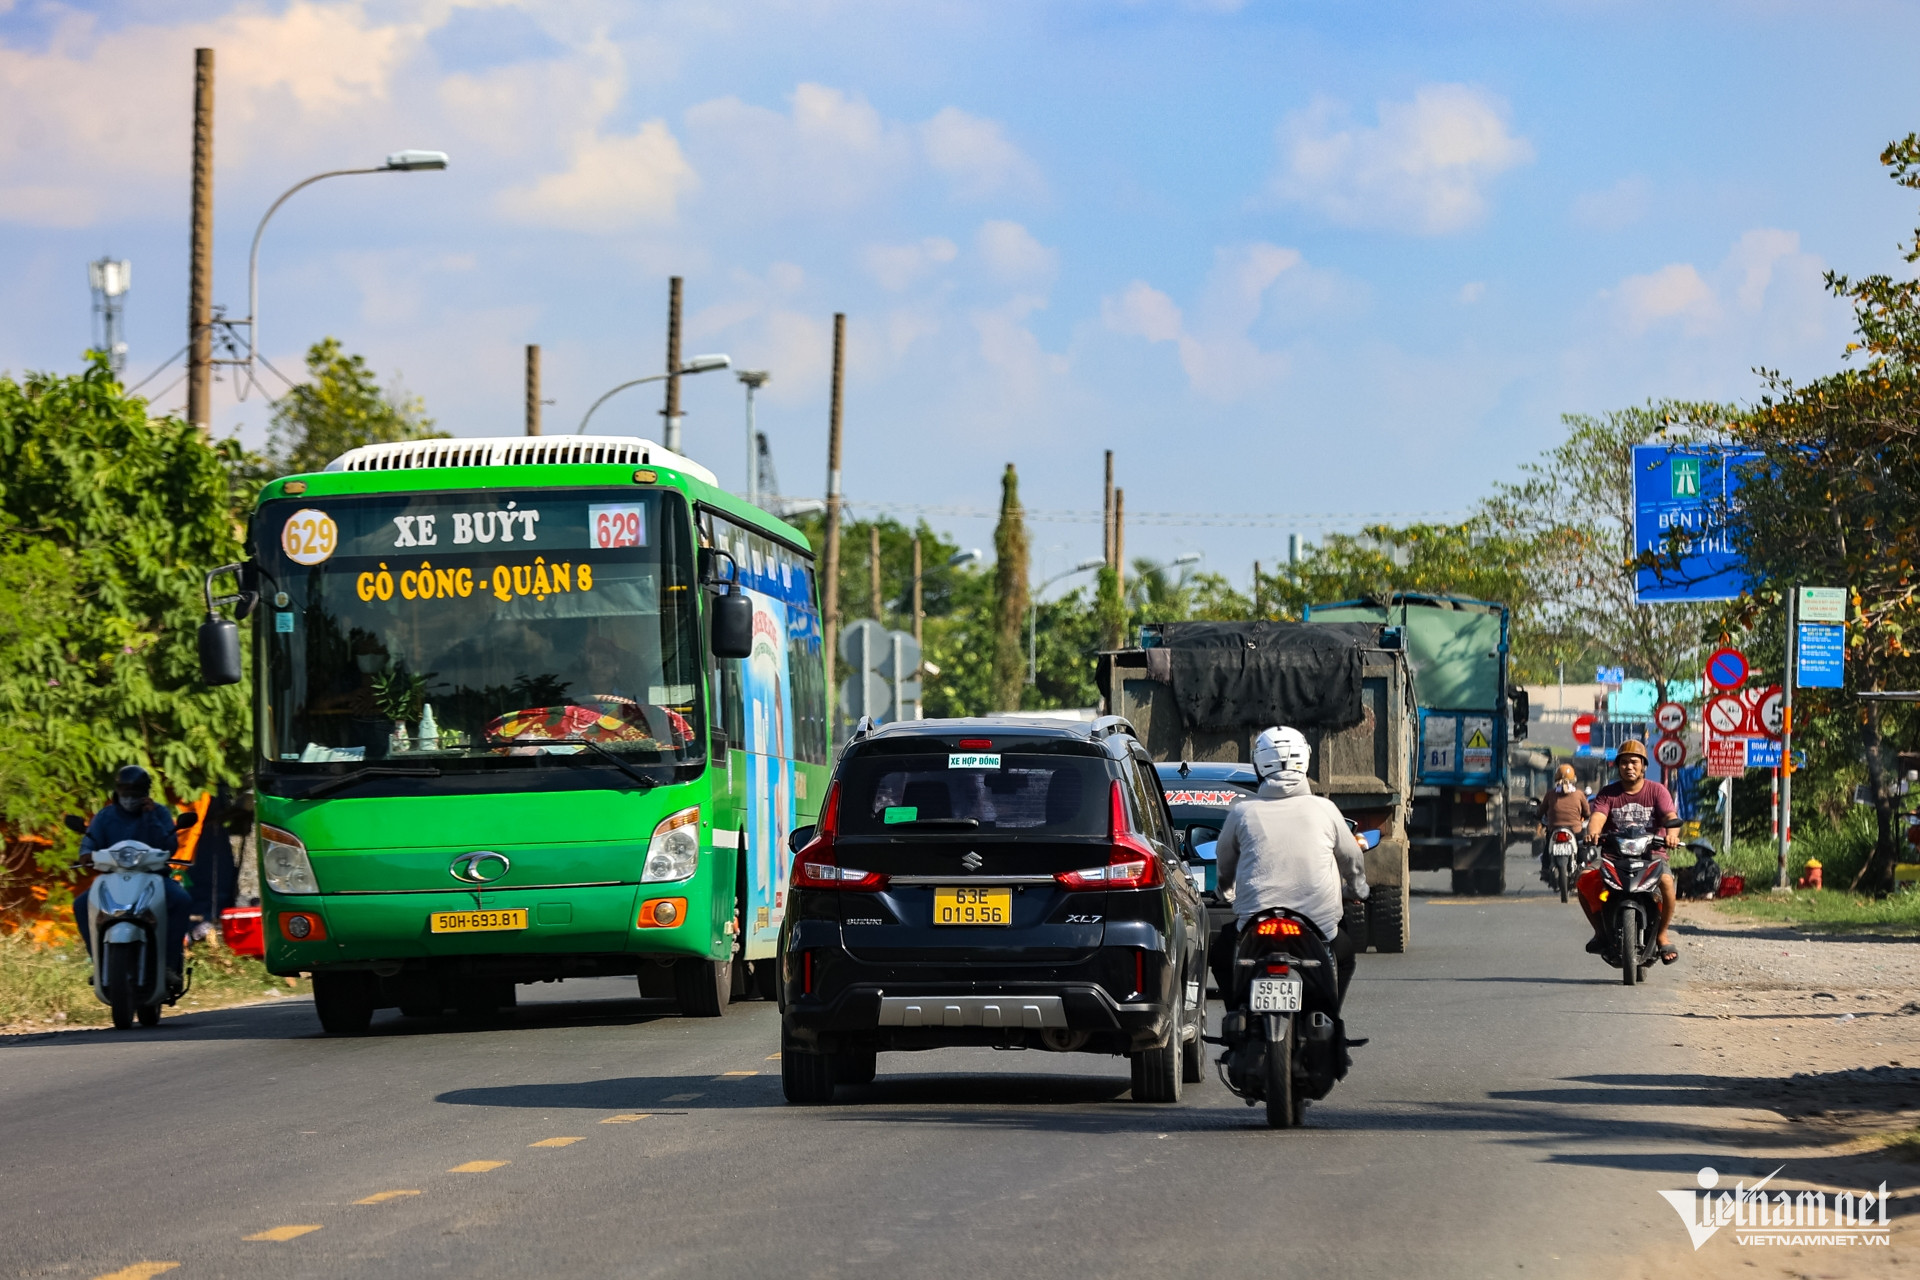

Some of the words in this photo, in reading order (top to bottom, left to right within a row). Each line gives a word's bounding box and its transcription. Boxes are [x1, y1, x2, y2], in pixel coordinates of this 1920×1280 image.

[393, 515, 437, 548] XE
[452, 501, 540, 545] BUÝT
[597, 512, 640, 549] 629
[286, 518, 333, 556] 629
[356, 562, 394, 601] GÒ
[400, 561, 474, 600] CÔNG
[493, 556, 570, 601] QUẬN
[577, 564, 593, 591] 8
[1662, 745, 1677, 761] 50
[950, 757, 960, 766] XE
[962, 756, 977, 766] HỢP
[956, 889, 989, 904] 63E
[440, 913, 518, 929] 50H-693.81
[942, 907, 1002, 922] 019.56
[1065, 914, 1103, 924] XL7
[1259, 982, 1293, 996] 59-CA
[1255, 997, 1297, 1010] 061.16
